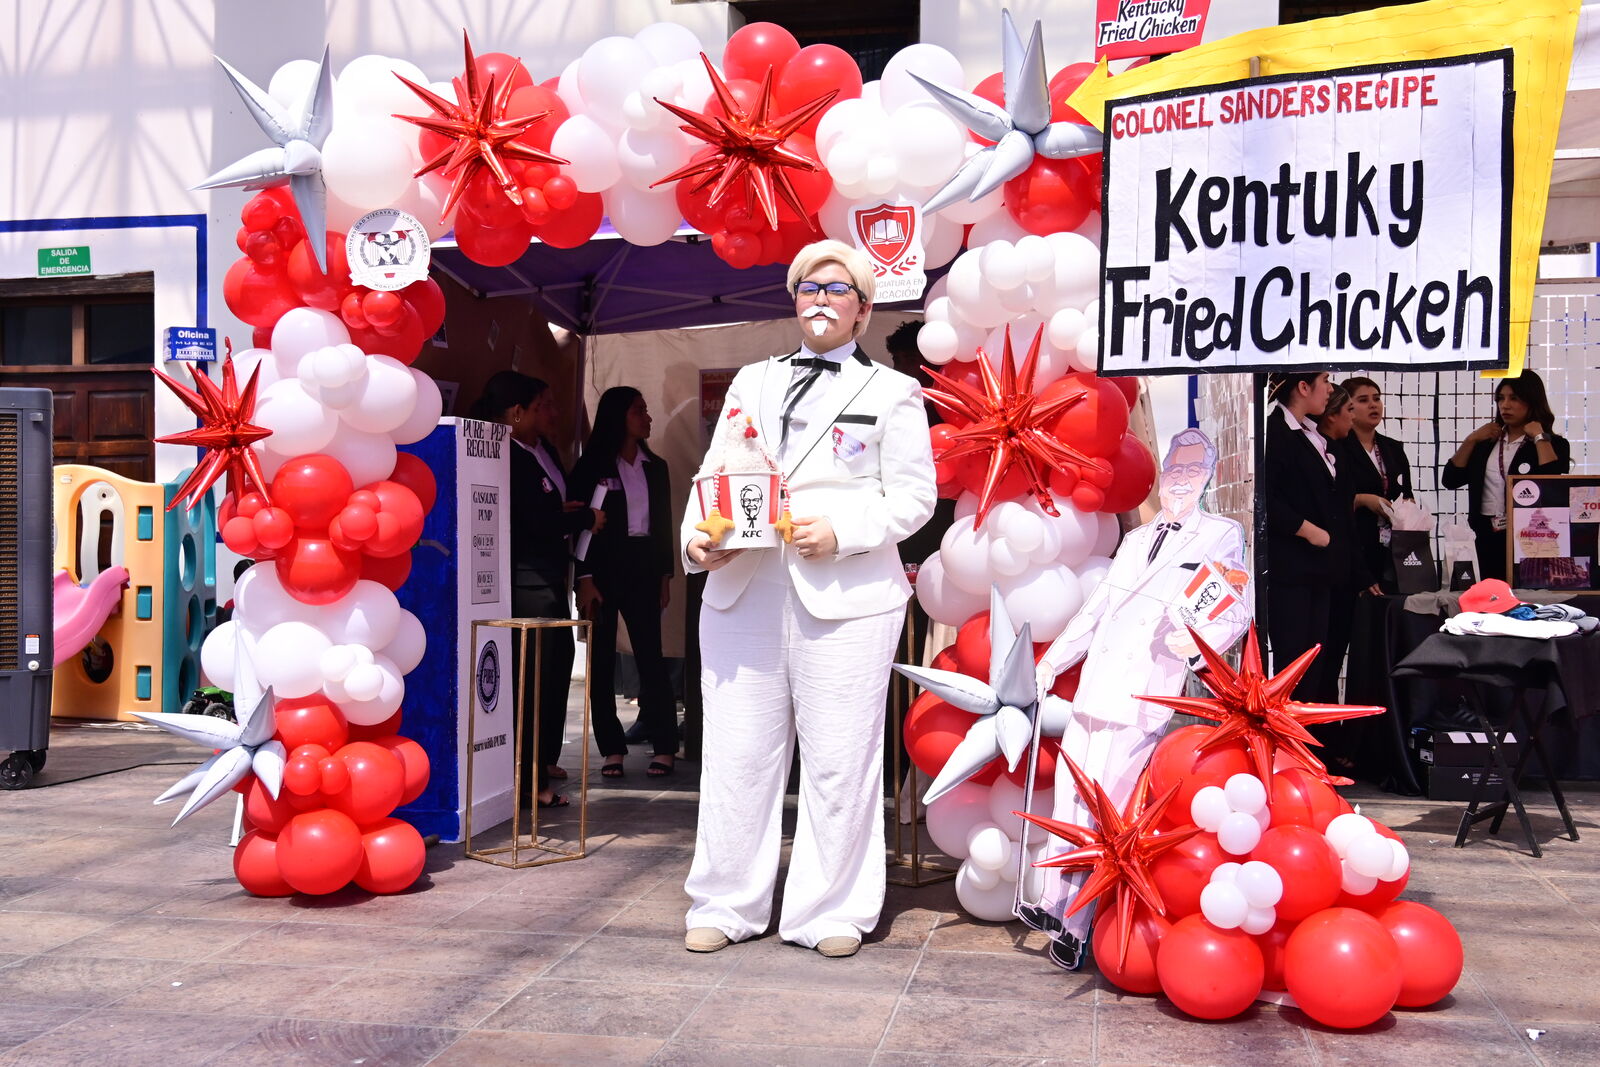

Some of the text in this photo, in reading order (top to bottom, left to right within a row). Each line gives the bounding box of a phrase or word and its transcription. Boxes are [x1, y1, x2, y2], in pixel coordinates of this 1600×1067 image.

[1117, 0, 1185, 22] Kentucky
[1099, 16, 1198, 45] Fried Chicken
[1111, 75, 1439, 140] COLONEL SANDERS RECIPE
[1154, 151, 1424, 262] Kentuky
[50, 248, 78, 257] SALIDA
[59, 257, 70, 265] DE
[41, 264, 90, 275] EMERGENCIA
[913, 277, 924, 286] EN
[875, 287, 919, 300] UCACIÓN
[1106, 265, 1495, 362] Fried Chicken
[177, 330, 210, 339] Oficina
[463, 419, 485, 440] PURE
[490, 423, 507, 442] PEP
[466, 438, 501, 459] REGULAR
[472, 490, 498, 505] GASOLINE
[478, 509, 493, 522] PUMP
[741, 529, 763, 538] KFC
